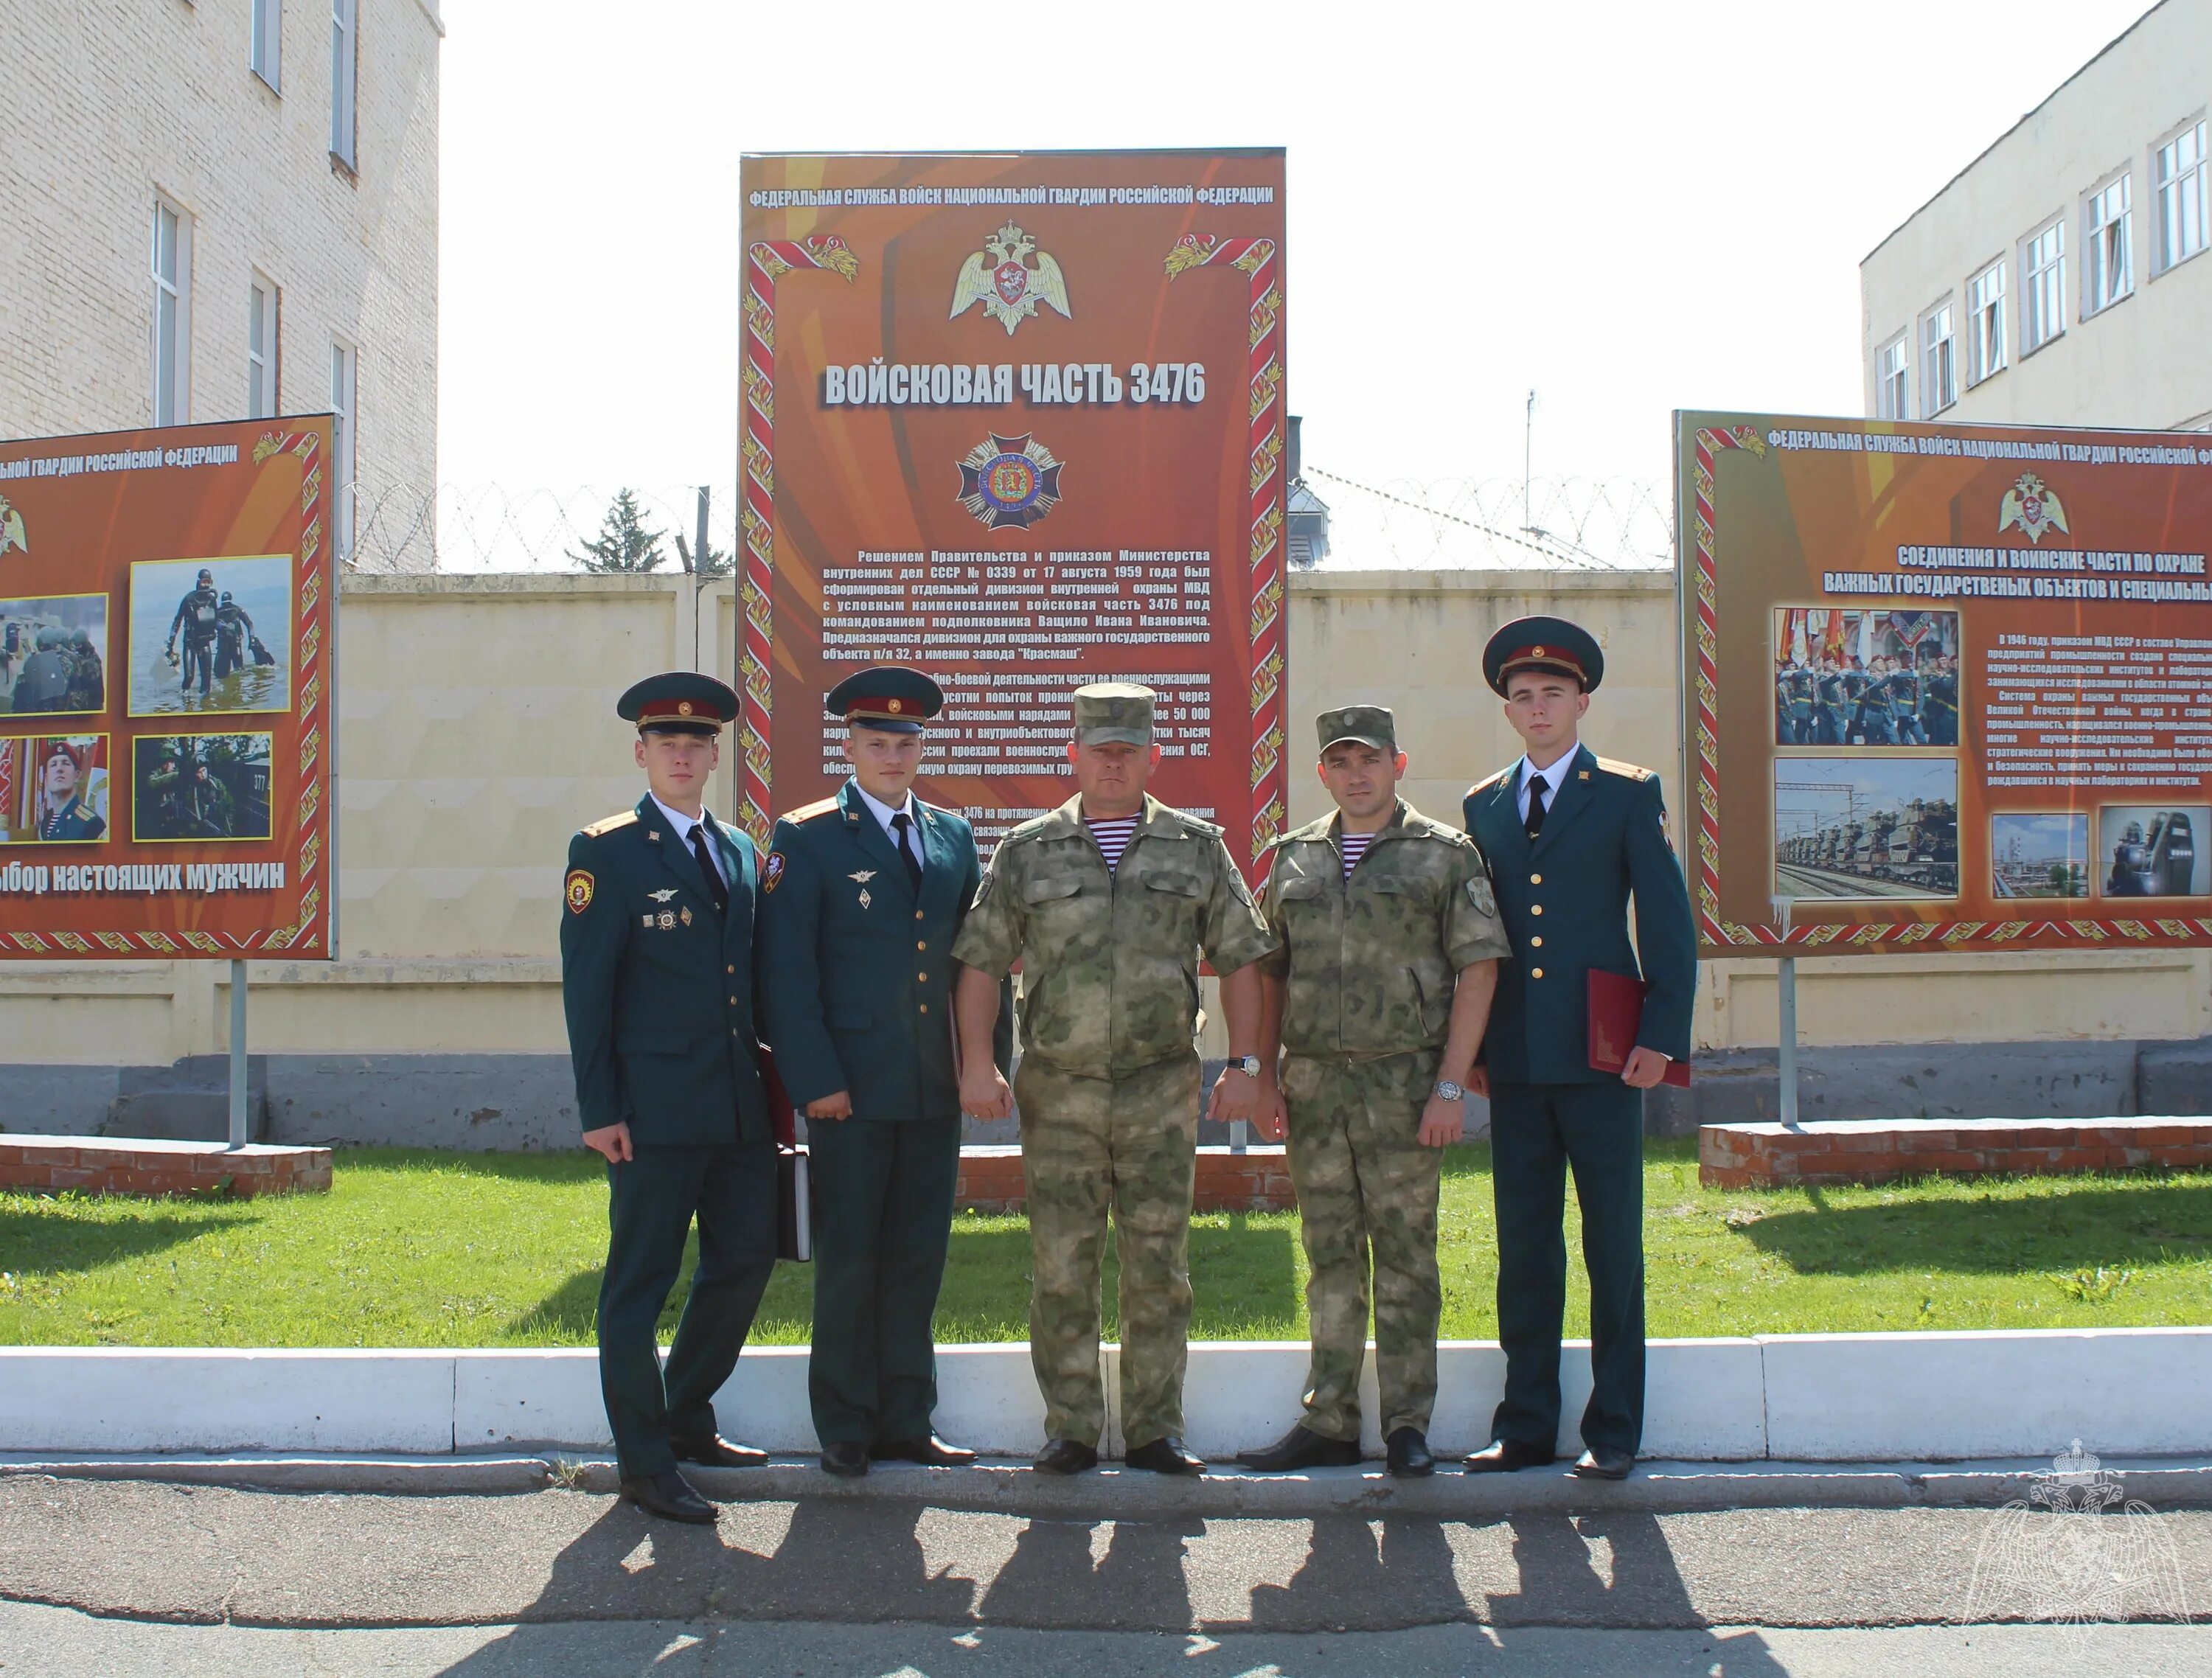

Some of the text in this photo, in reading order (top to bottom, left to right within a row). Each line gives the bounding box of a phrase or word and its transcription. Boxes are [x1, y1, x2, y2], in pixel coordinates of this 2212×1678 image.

[749, 184, 1274, 208] ФЕДЕРАЛЬНАЯ СЛУЖБА ВОЙСК НАЦИОНАЛЬНОЙ ГВАРДИИ РОССИЙСКОЙ ФЕДЕРАЦИИ
[827, 357, 1206, 403] ВОЙСКОВАЯ ЧАСТЬ 3476
[1768, 430, 1863, 450] ФЕДЕРАЛЬНАЯ
[1864, 434, 1917, 453] СЛУЖБА
[1919, 436, 1961, 456] ВОЙСК
[1963, 440, 2060, 460] НАЦИОНАЛЬНОЙ
[2062, 444, 2116, 464] ГВАРДИИ
[2119, 445, 2197, 464] РОССИЙСКОЙ
[32, 456, 83, 477] ГВАРДИИ
[86, 447, 163, 473] РОССИЙСКОЙ
[164, 445, 237, 467] ФЕДЕРАЦИИ
[858, 550, 1210, 563] Решением Правительства и приказом Министерства
[1898, 546, 2205, 573] СОЕДИНЕНИЯ И ВОИНСКИЕ ЧАСТИ ПО ОХРАНЕ
[824, 566, 1210, 579] внутренних дел СССР № 0339 от 17 августа 1959 года был
[824, 582, 1210, 596] сформирован отдельный дивизион внутренней охраны МВД
[1823, 573, 1893, 593] ВАЖНЫХ
[1896, 574, 2032, 596] ГОСУДАРСТВЕНЫХ
[2034, 577, 2107, 598] ОБЪЕКТОВ
[2110, 579, 2119, 598] И
[823, 598, 1210, 612] с условным наименованием войсковая часть 3476 под
[823, 615, 1210, 628] командованием подполковника Ващило Ивана Ивановича.
[823, 632, 1210, 644] Предназначался дивизион для охраны важного государственного
[1999, 634, 2005, 644] В
[2007, 635, 2026, 644] 1946
[2051, 637, 2093, 646] приказом
[2114, 636, 2134, 647] СССР
[2143, 638, 2174, 647] составе
[823, 648, 870, 660] объекта
[874, 648, 893, 660] п/я
[896, 648, 912, 660] 32,
[915, 650, 922, 660] а
[925, 650, 969, 660] именно
[973, 650, 1015, 661] завода
[1988, 649, 2045, 660] предприятий
[2051, 650, 2125, 660] промышленности
[993, 674, 1065, 686] деятельности
[1067, 674, 1095, 685] части
[1098, 674, 1107, 683] ее
[1111, 673, 1210, 685] военнослужащими
[941, 692, 979, 703] усотни
[986, 692, 1032, 703] попыток
[1179, 692, 1210, 703] через
[1999, 691, 2036, 701] Система
[949, 708, 1015, 721] войсковыми
[1020, 710, 1071, 722] нарядами
[1174, 708, 1185, 720] 50
[1191, 708, 1210, 720] 000
[1987, 704, 2024, 715] Великой
[2033, 705, 2096, 715] Отечественной
[966, 728, 972, 737] и
[1178, 727, 1210, 737] тысяч
[1987, 734, 2018, 743] многие
[922, 745, 945, 756] ссии
[952, 745, 999, 757] проехали
[1006, 745, 1068, 757] военнослуж
[1191, 743, 1210, 757] ОСГ,
[947, 763, 982, 775] охрану
[984, 763, 1054, 775] перевозимых
[964, 806, 982, 818] 3476
[985, 808, 995, 818] на
[53, 863, 181, 894] настоящих
[187, 862, 285, 894] мужчин
